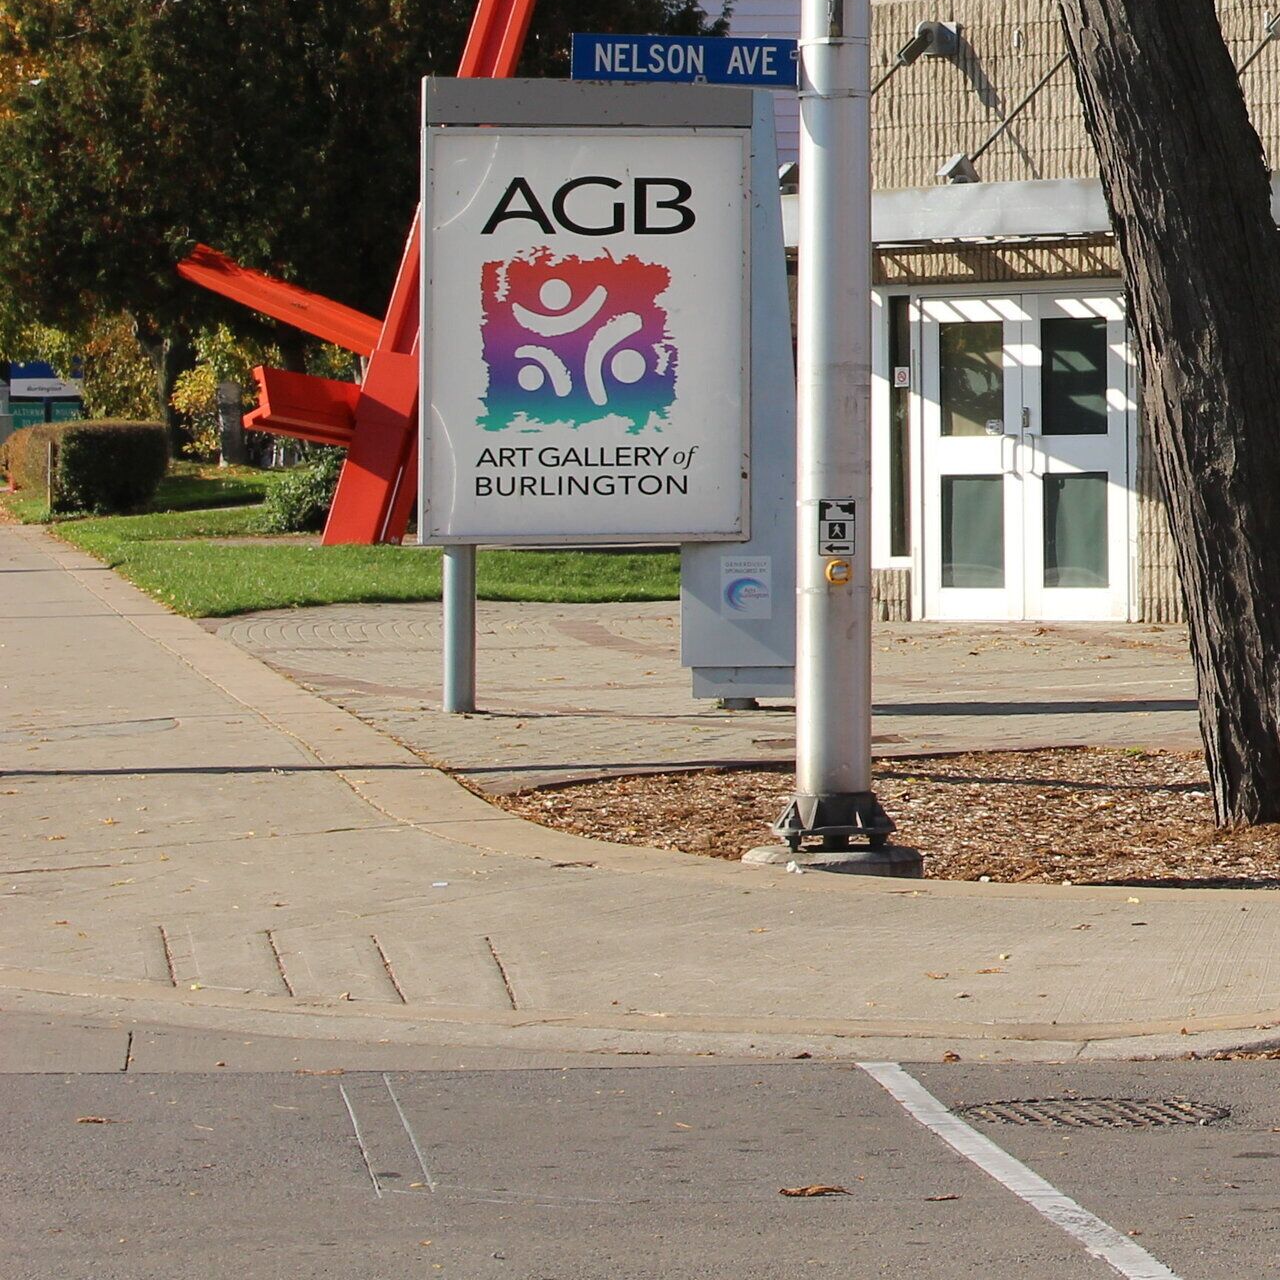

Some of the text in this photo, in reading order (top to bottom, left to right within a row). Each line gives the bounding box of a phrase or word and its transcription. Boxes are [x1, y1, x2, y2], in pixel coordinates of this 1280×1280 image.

[595, 43, 777, 76] NELSON AVE
[481, 176, 695, 236] AGB
[476, 445, 699, 470] ART GALLERY of
[476, 475, 688, 496] BURLINGTON
